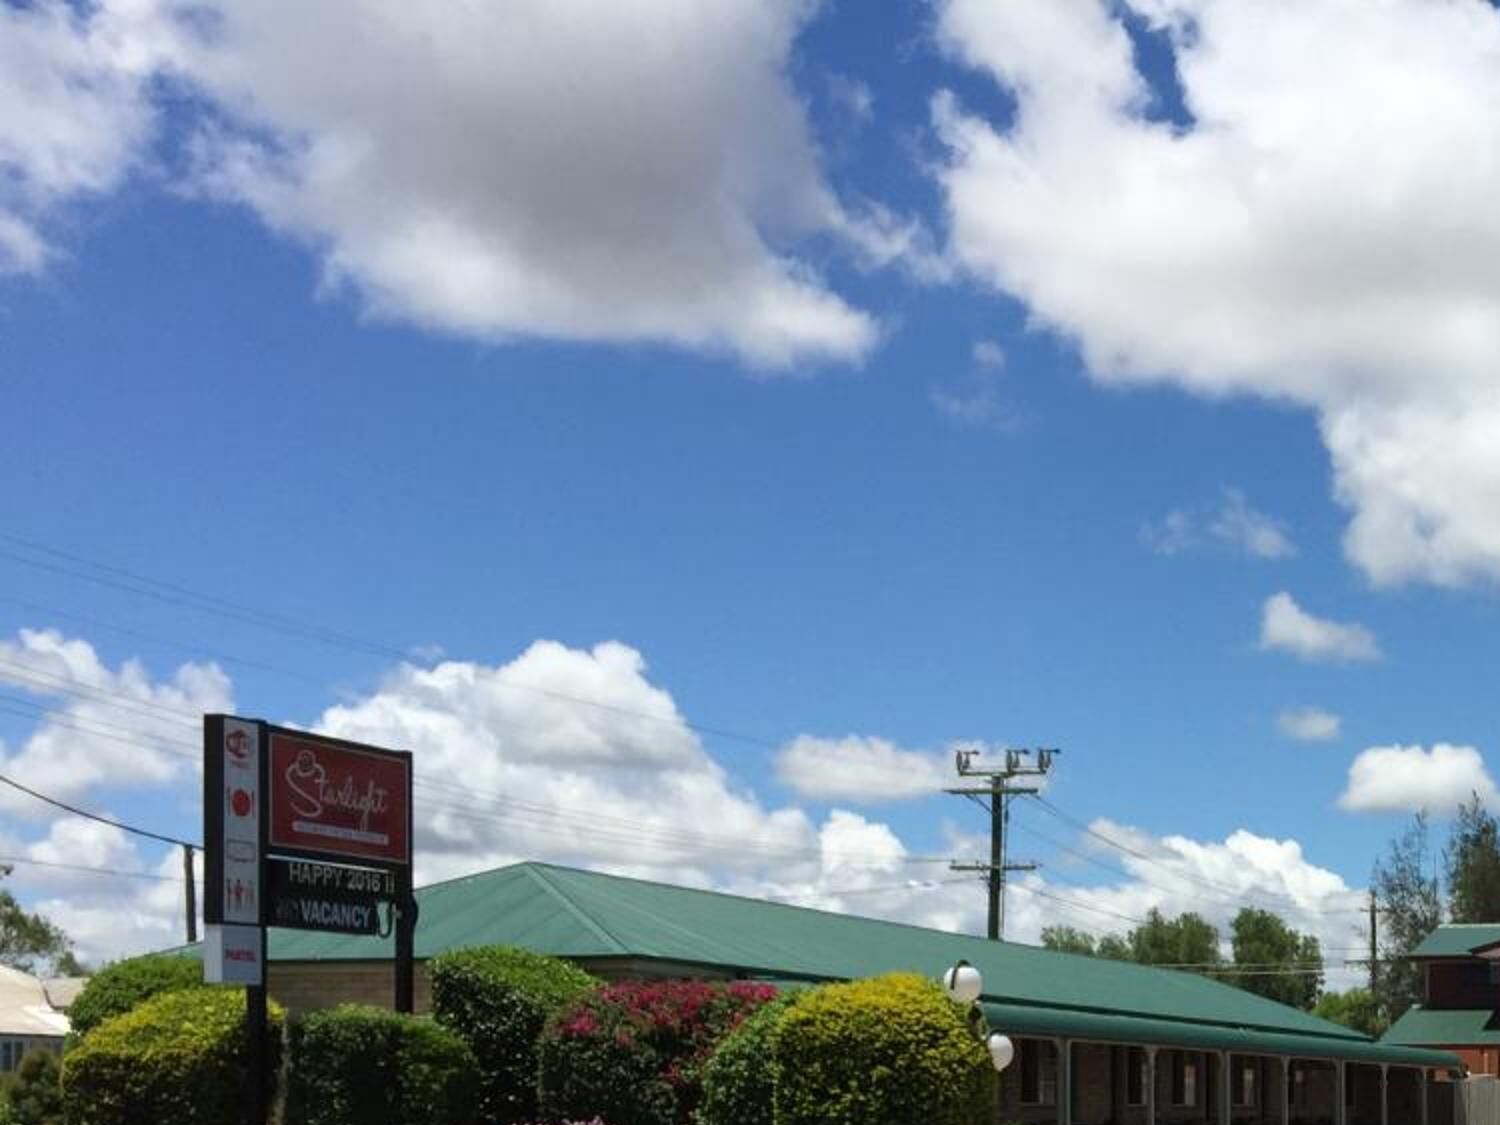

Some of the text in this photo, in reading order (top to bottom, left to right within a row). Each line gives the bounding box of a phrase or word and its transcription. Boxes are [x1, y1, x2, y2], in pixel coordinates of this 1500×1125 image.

[289, 863, 342, 888] HAPPY
[347, 869, 380, 892] 2016
[301, 899, 369, 928] VACANCY
